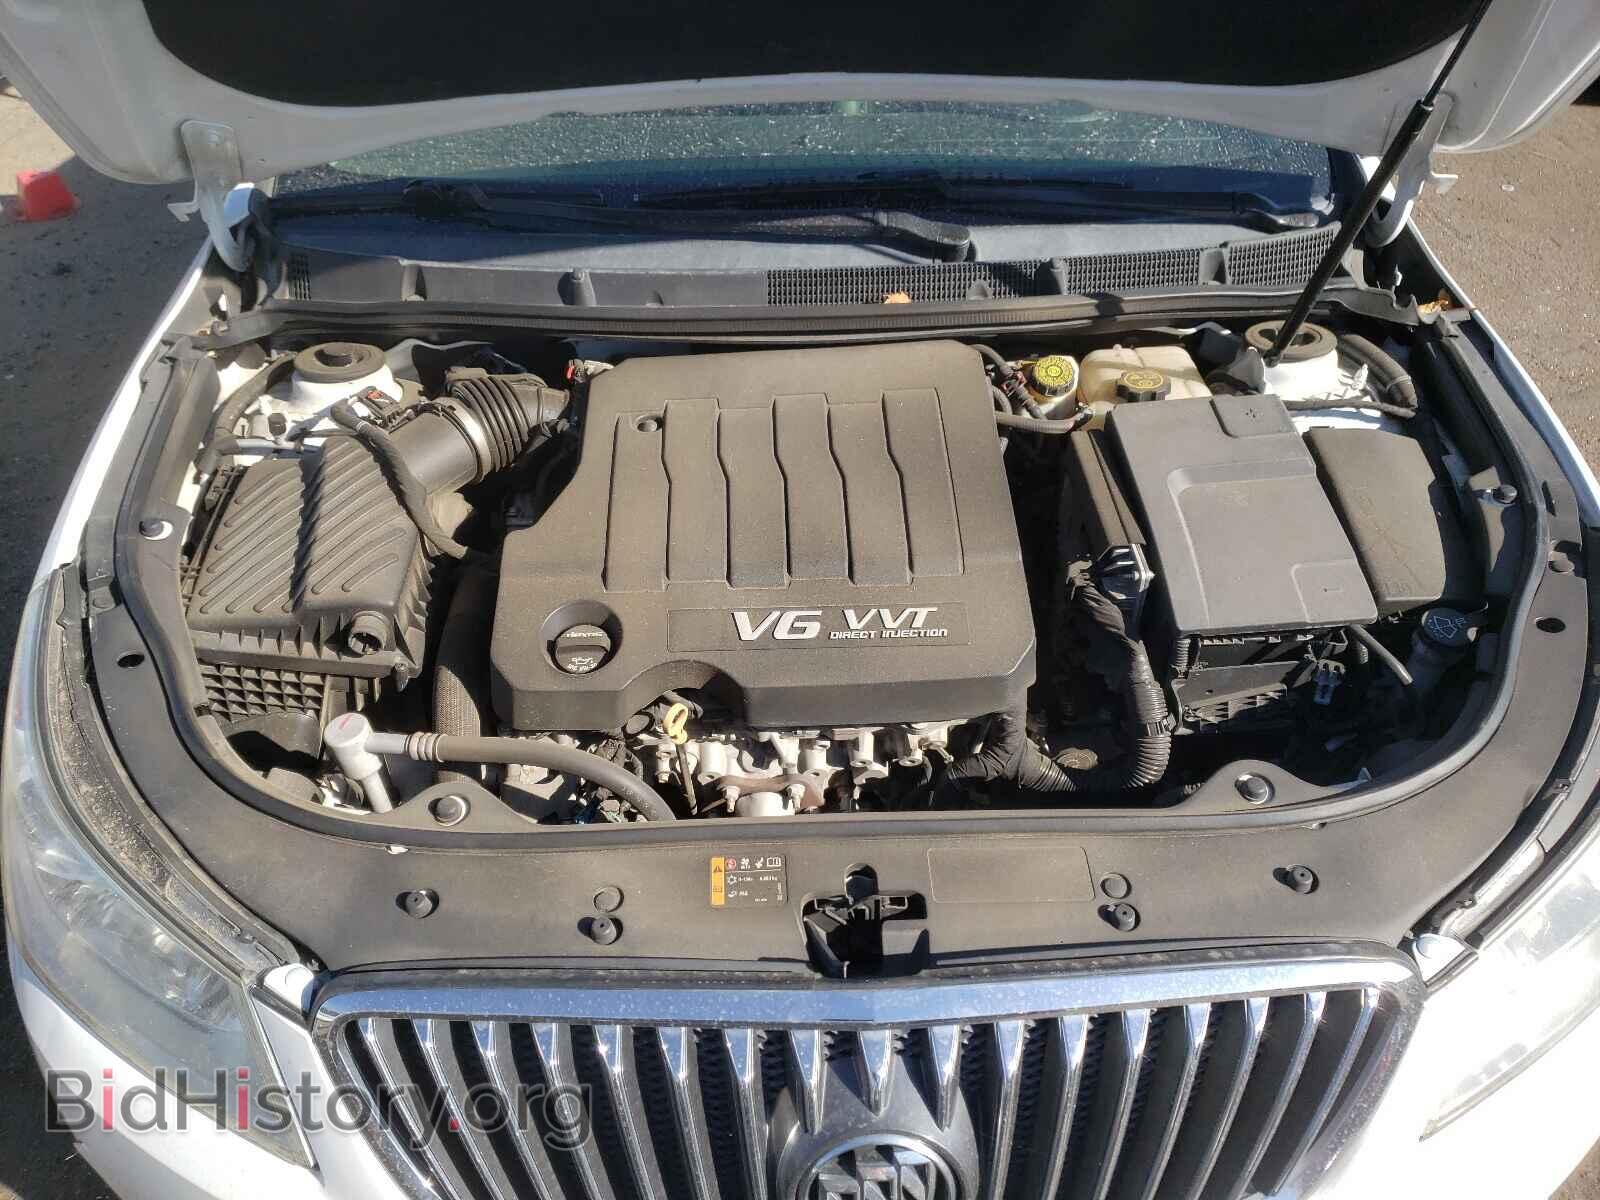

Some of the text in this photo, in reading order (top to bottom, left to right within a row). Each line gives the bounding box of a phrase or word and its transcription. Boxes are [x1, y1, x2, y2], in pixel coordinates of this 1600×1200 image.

[731, 607, 938, 641] V6 VVT
[829, 628, 948, 640] DIRECT INJECTION
